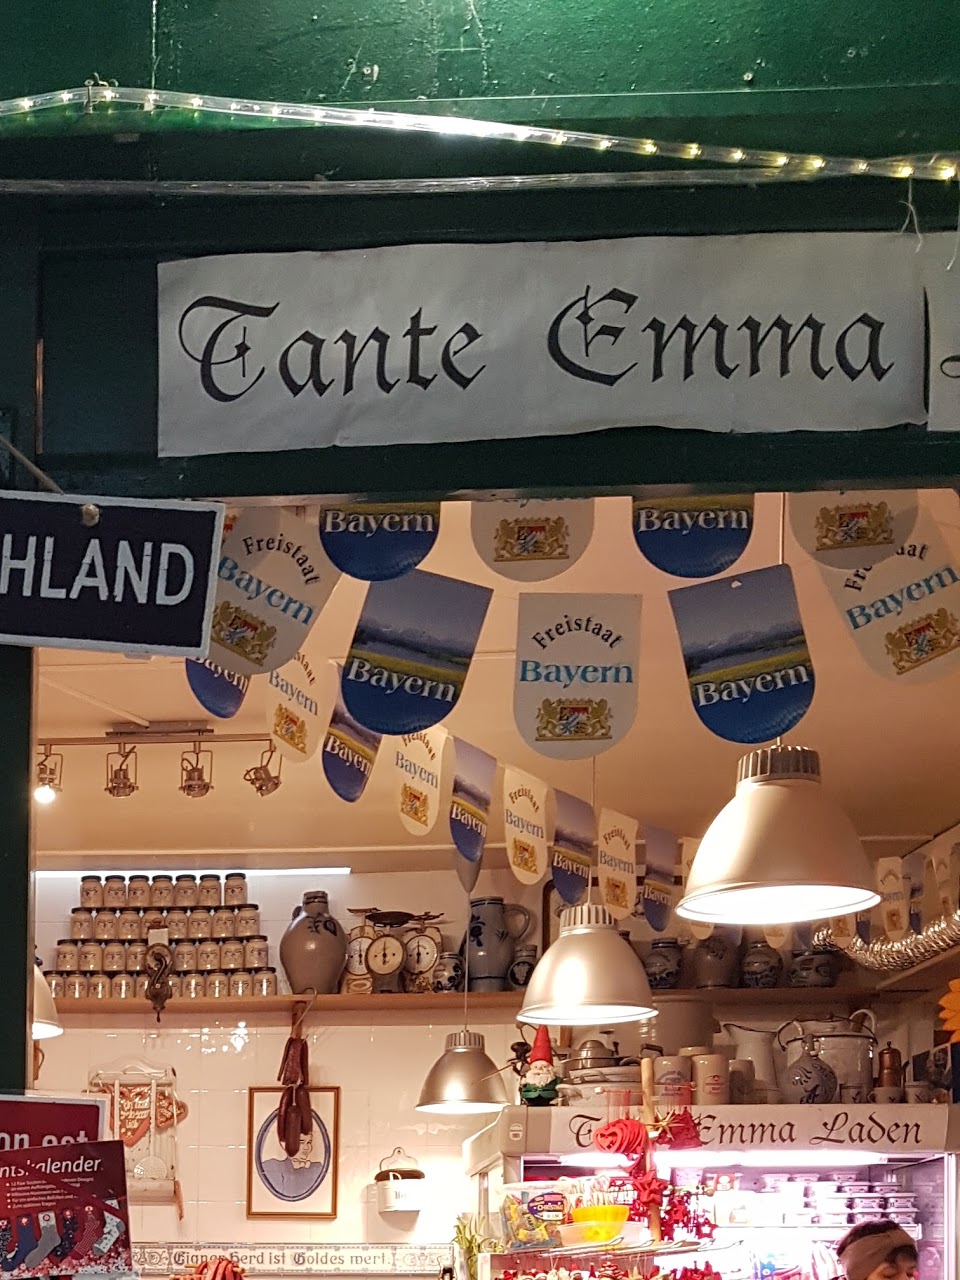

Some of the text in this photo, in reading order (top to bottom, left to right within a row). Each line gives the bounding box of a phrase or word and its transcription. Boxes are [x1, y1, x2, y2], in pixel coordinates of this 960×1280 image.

[179, 284, 894, 402] Tante Emma
[324, 509, 435, 538] Bayern
[639, 508, 750, 536] Bayern
[242, 533, 322, 585] Freistaat
[218, 555, 315, 626] Bayern
[846, 563, 960, 631] Bayern
[531, 613, 625, 651] Freistaat
[194, 655, 250, 694] ayern
[269, 670, 319, 716] Bayern
[347, 657, 456, 703] Bayern
[519, 659, 634, 690] Bayern
[695, 663, 810, 708] Bayern
[325, 734, 373, 776] Bayern
[395, 750, 439, 789] Bayern
[451, 802, 487, 838] Bayern
[505, 807, 545, 840] Bayern
[553, 850, 590, 879] Bayern
[599, 850, 635, 875] Bayern
[809, 1111, 922, 1145] Laden
[269, 1252, 286, 1265] ist
[350, 1252, 391, 1266] wert.
